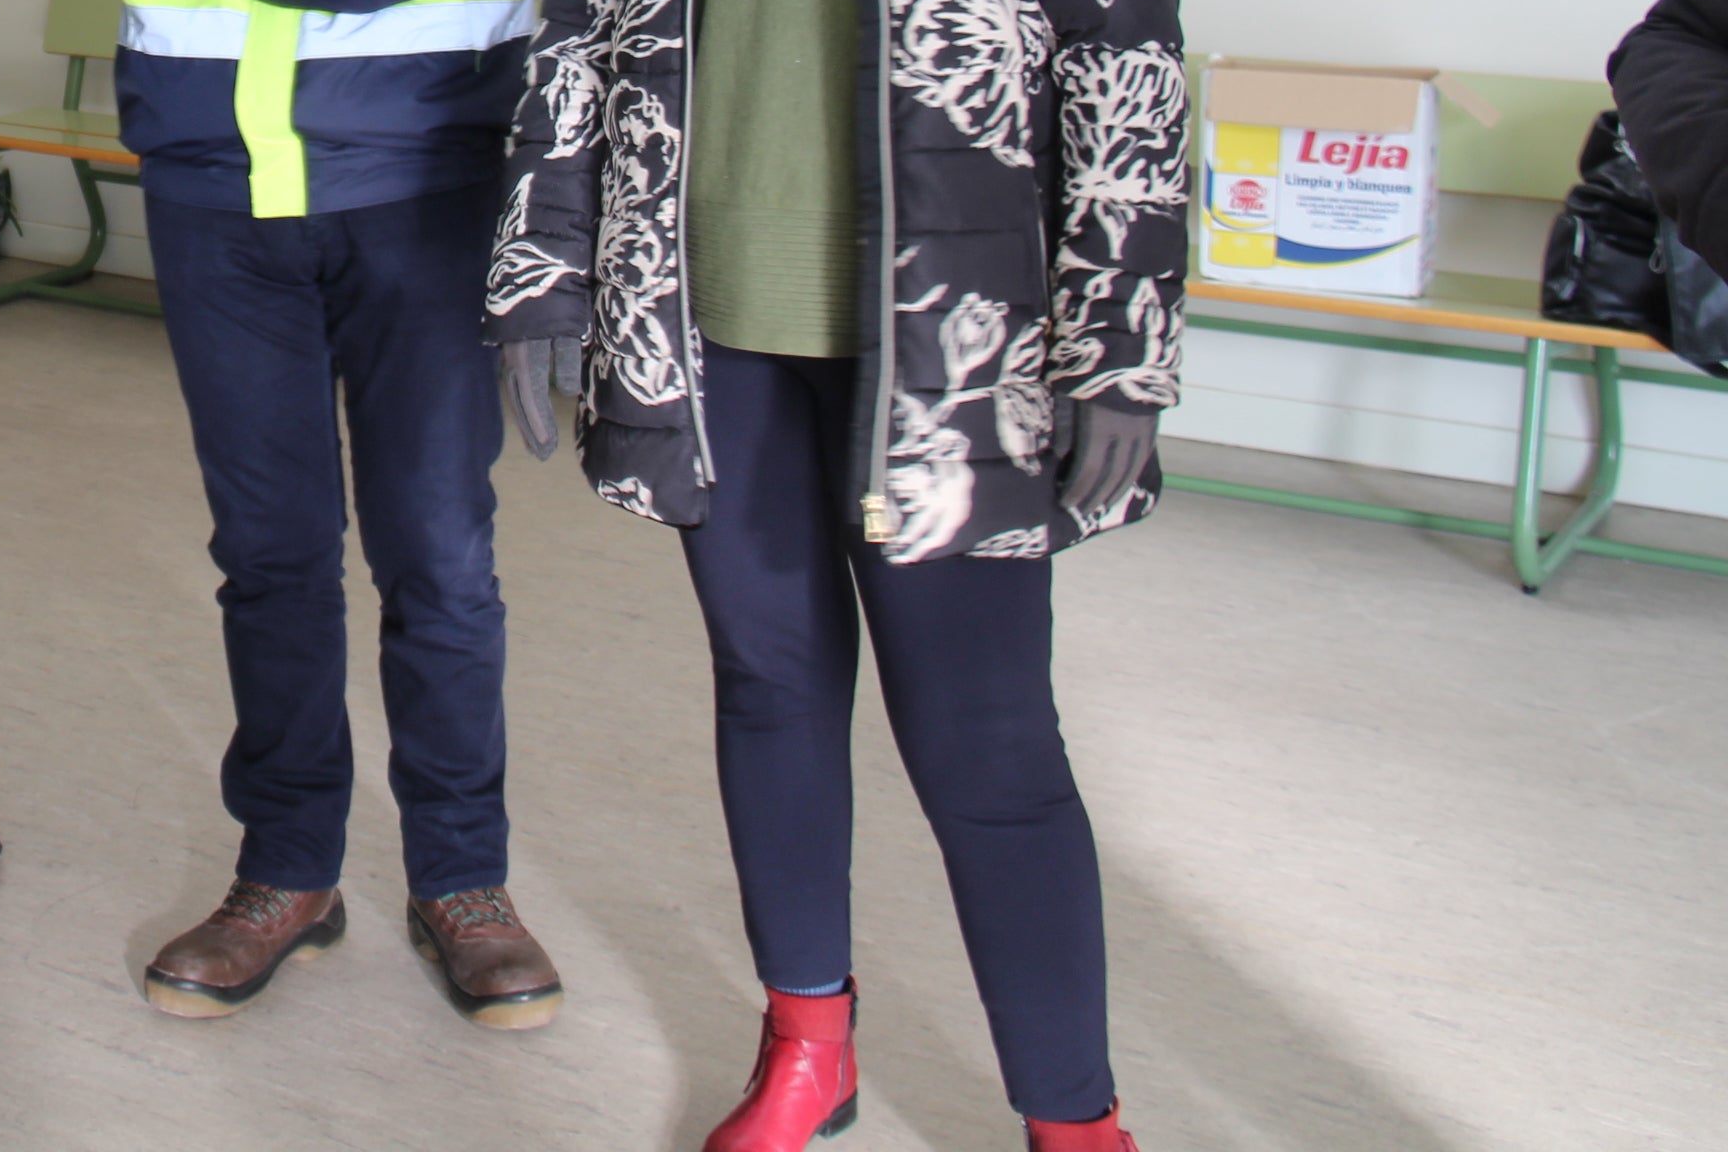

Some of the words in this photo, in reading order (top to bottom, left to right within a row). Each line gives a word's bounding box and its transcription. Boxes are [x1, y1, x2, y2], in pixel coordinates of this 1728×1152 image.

[1296, 130, 1409, 175] Lejía
[1284, 173, 1332, 191] Limpia
[1334, 178, 1344, 193] y
[1347, 177, 1413, 195] blanquea
